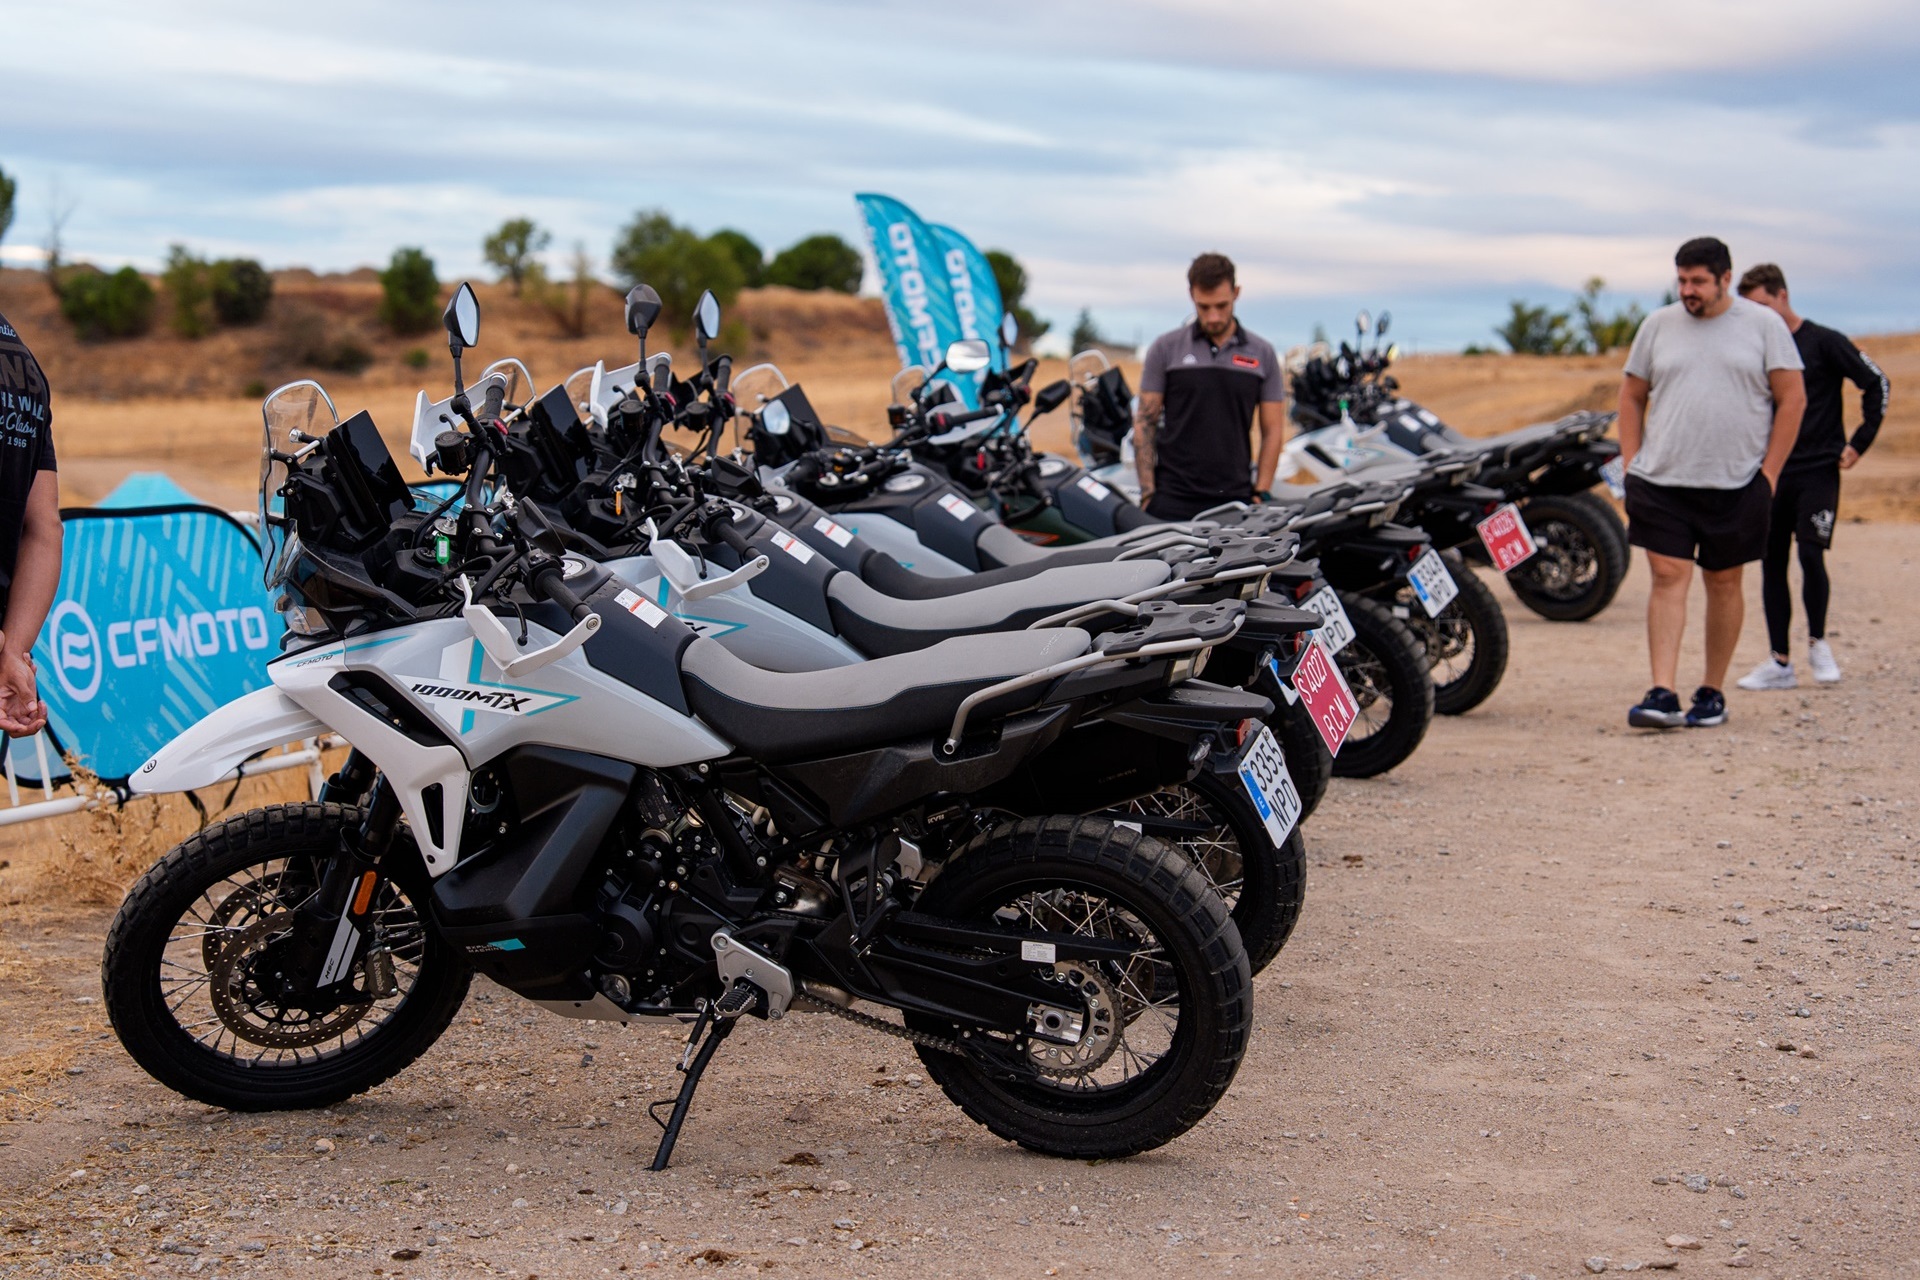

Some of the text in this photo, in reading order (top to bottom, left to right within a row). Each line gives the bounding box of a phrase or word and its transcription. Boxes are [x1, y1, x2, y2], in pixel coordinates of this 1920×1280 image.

[0, 353, 43, 395] NS
[1306, 593, 1339, 616] 343
[107, 606, 269, 668] CFMOTO
[297, 655, 333, 667] CFMOTO
[1323, 693, 1351, 743] BCM
[1250, 738, 1284, 793] 3355
[1268, 778, 1298, 832] NPD
